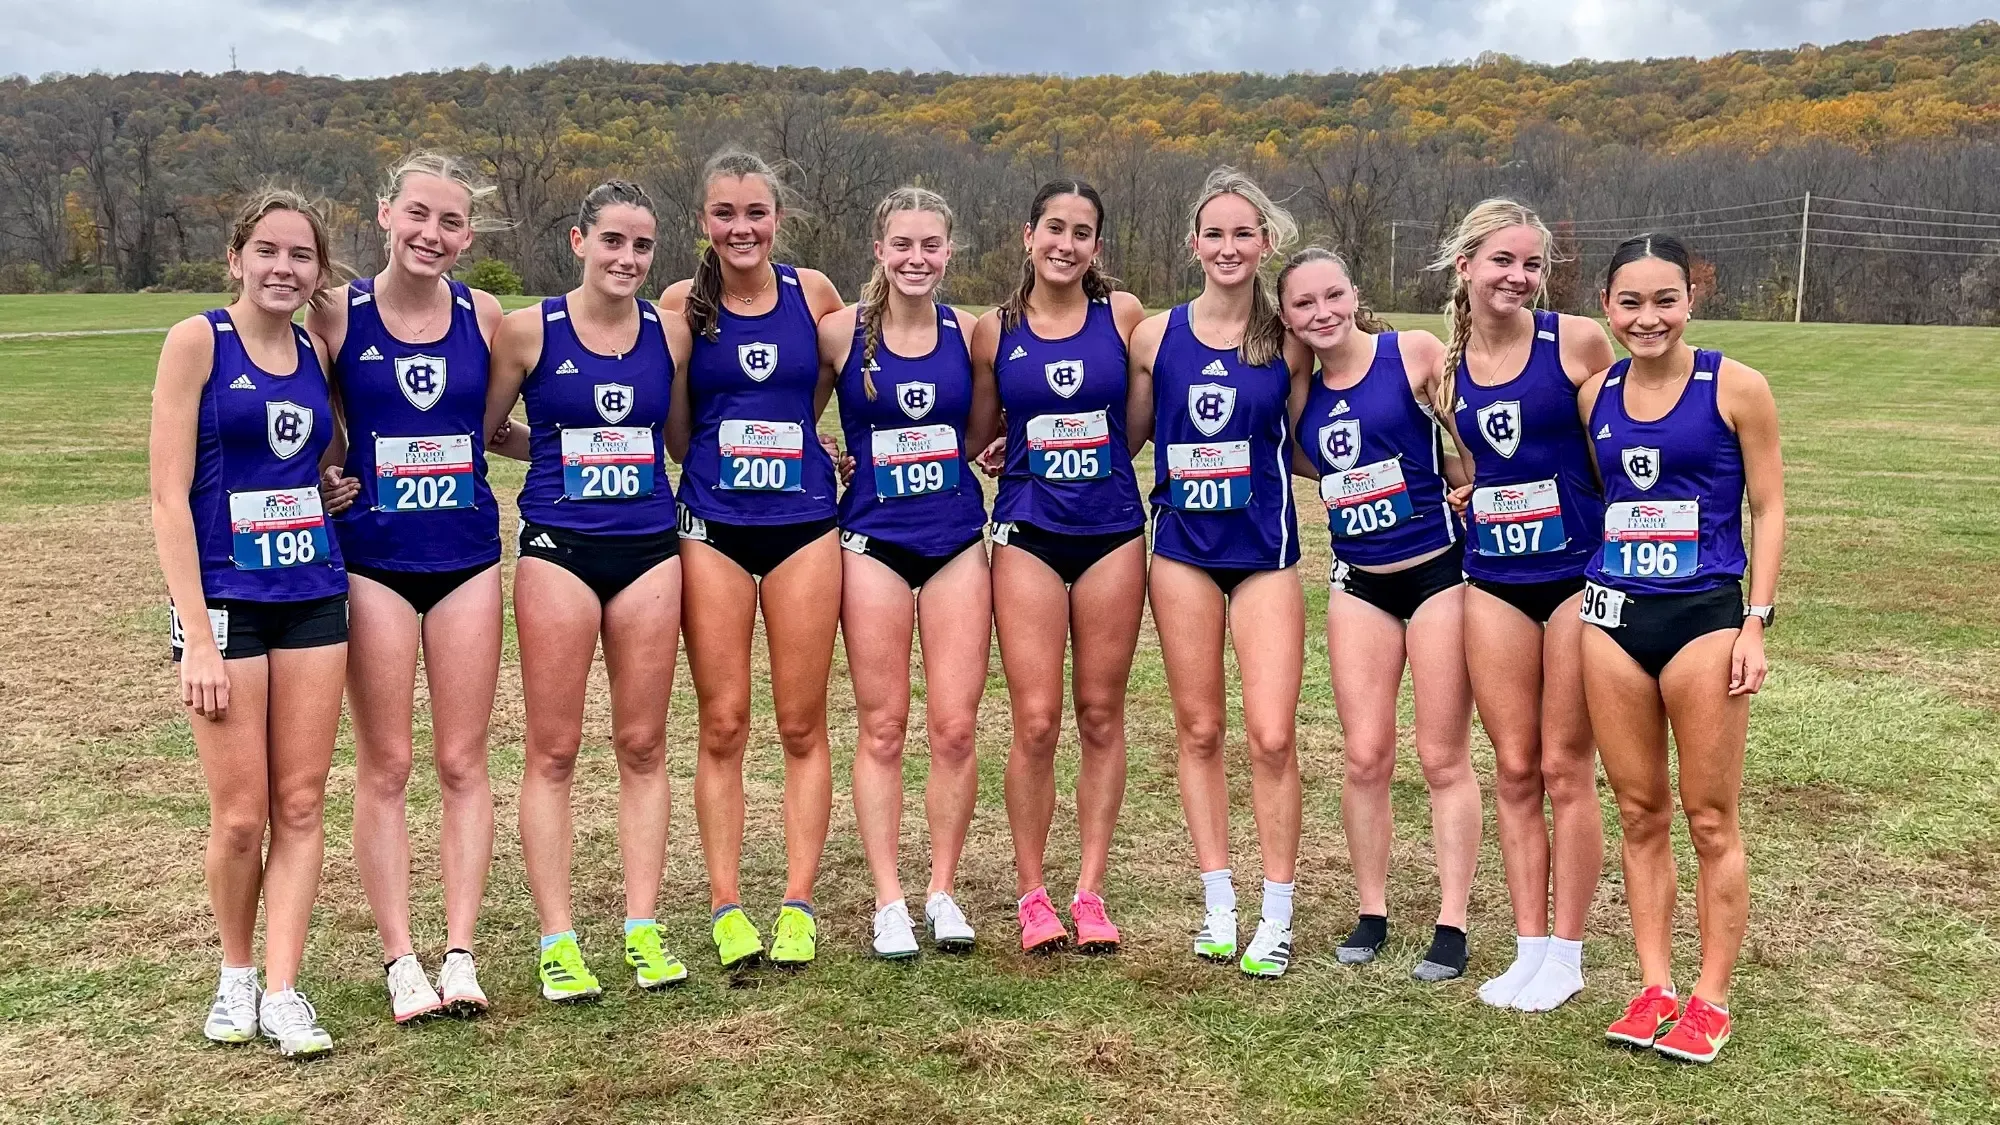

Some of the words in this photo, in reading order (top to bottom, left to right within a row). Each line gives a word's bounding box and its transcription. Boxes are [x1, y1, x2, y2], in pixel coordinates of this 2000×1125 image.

[896, 440, 932, 448] PATRIOT
[732, 458, 786, 488] 200
[890, 462, 944, 494] 199
[1044, 449, 1098, 478] 205
[396, 476, 458, 509] 202
[582, 466, 640, 496] 206
[1183, 478, 1232, 508] 201
[1342, 478, 1376, 490] PATRIOT
[1343, 483, 1377, 495] LEAGUE
[263, 505, 302, 513] PATRIOT
[263, 511, 302, 519] LEAGUE
[1342, 499, 1396, 536] 203
[1493, 498, 1528, 507] PATRIOT
[1493, 503, 1530, 512] LEAGUE
[254, 530, 315, 566] 198
[1490, 520, 1544, 554] 197
[1620, 542, 1678, 576] 196
[1580, 586, 1608, 619] 96
